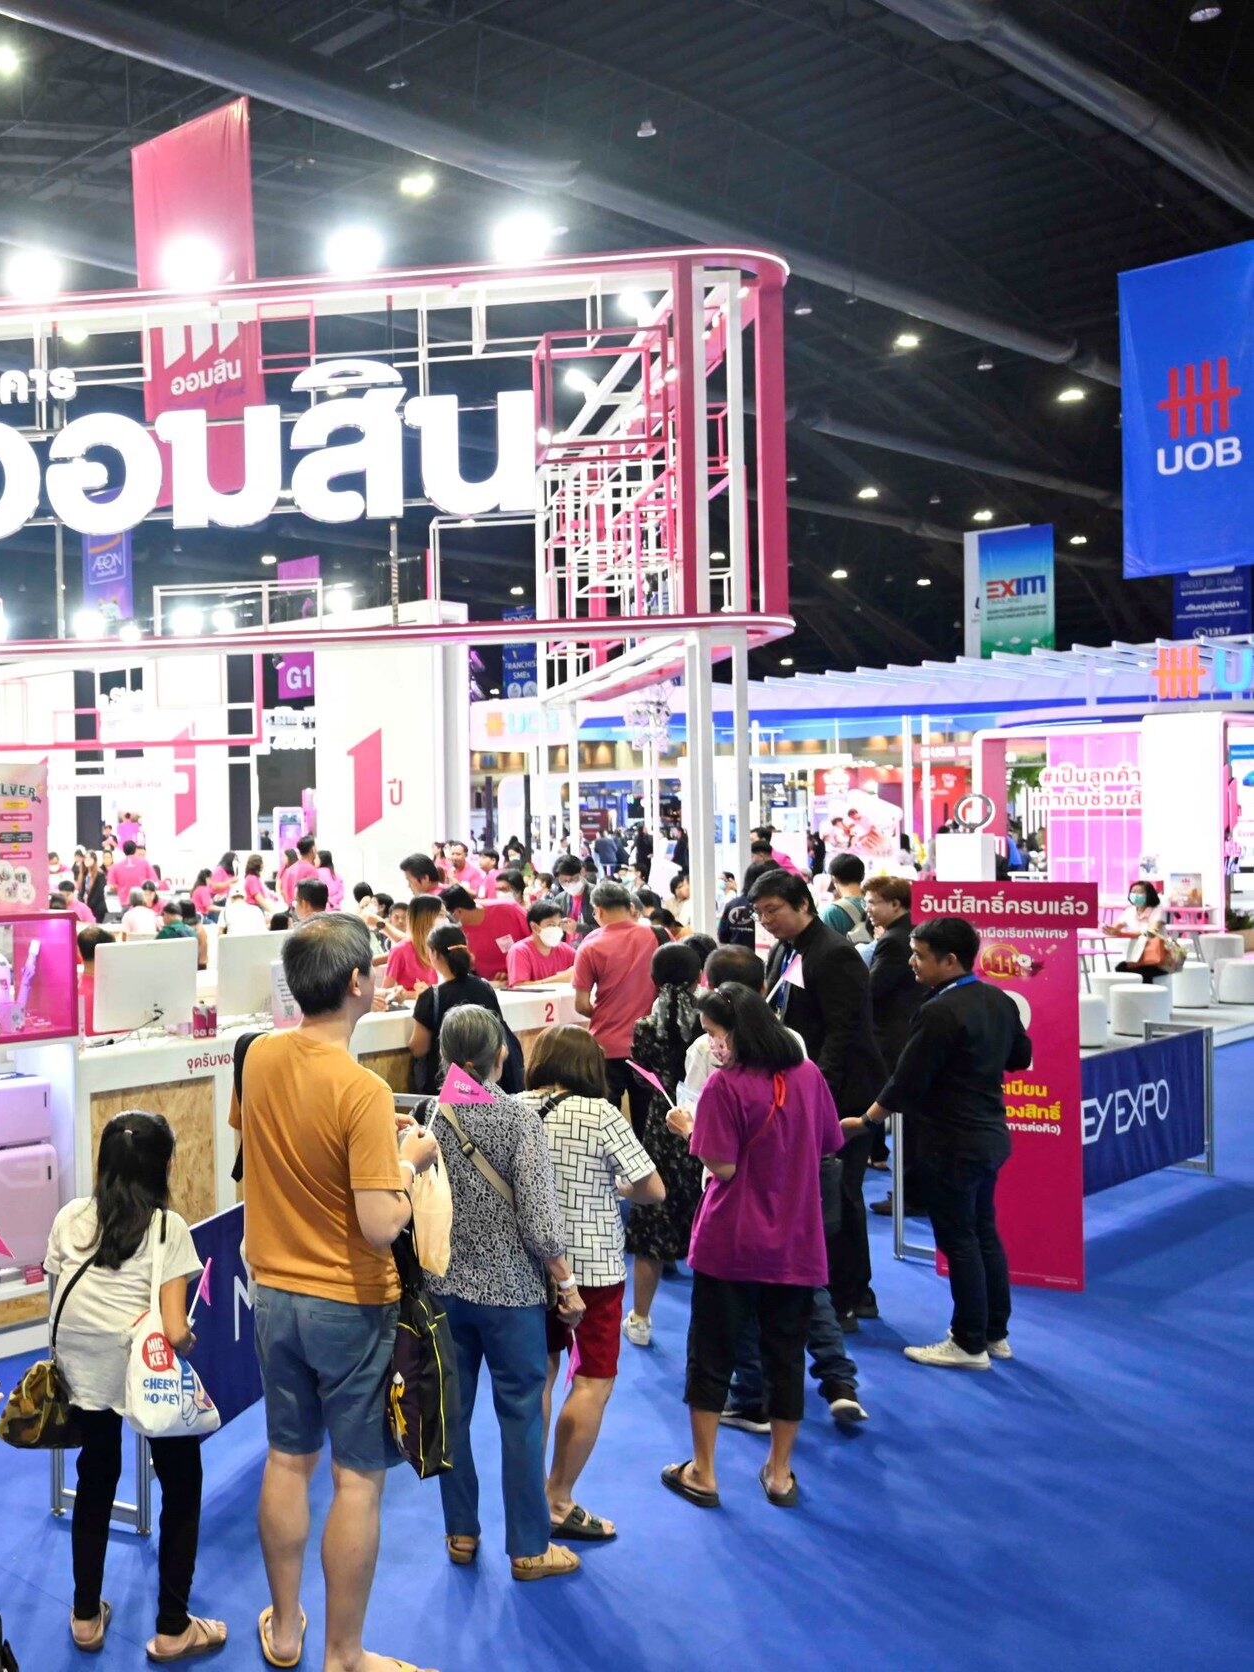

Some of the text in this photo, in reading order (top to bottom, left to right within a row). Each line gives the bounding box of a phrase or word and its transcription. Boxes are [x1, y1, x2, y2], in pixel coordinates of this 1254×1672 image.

[170, 358, 242, 396] ออมสิน
[1157, 436, 1243, 476] UOB
[986, 575, 1046, 600] EXIM
[286, 665, 312, 691] G1
[920, 888, 1089, 916] วันนี้สิทธิ์ครบแล้ว
[545, 1002, 554, 1023] 2
[1115, 1079, 1170, 1135] EXPO
[146, 1337, 165, 1352] MIC
[148, 1351, 169, 1367] KEY
[143, 1377, 179, 1391] CHEEKY
[144, 1393, 180, 1405] MONKEY
